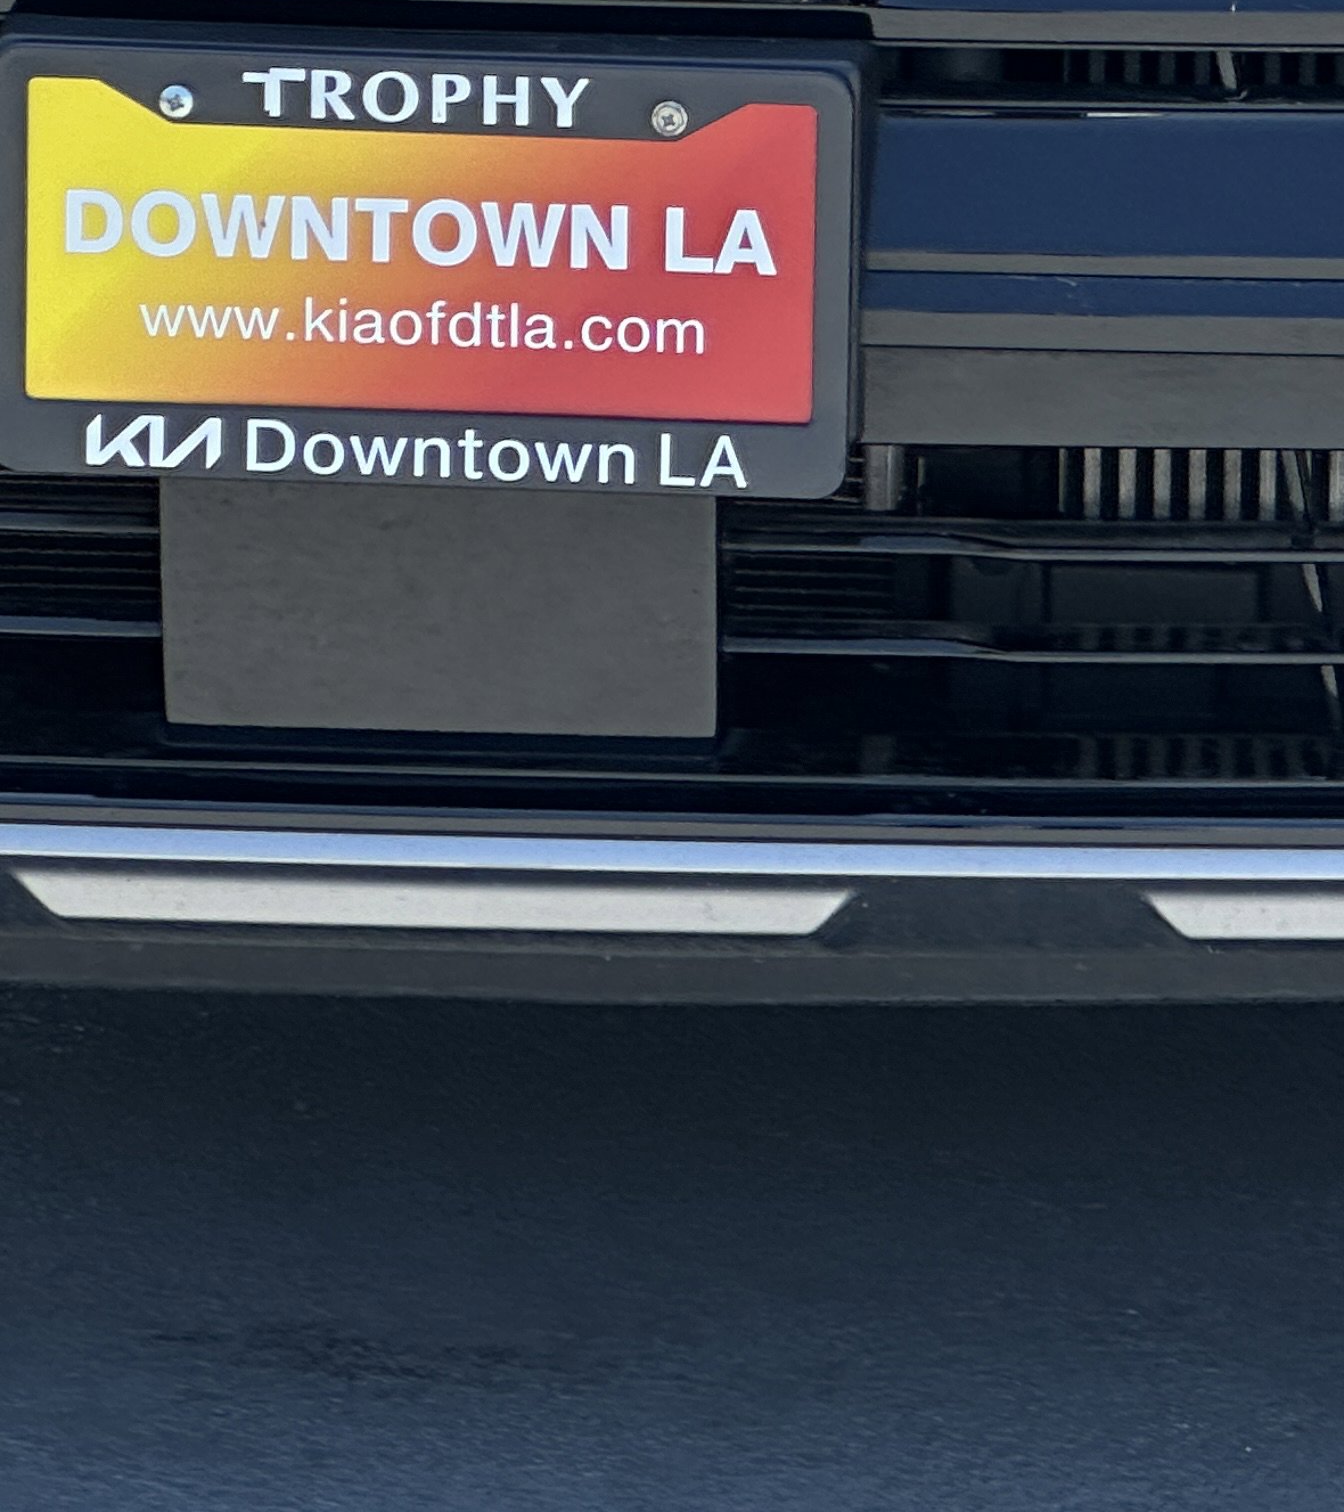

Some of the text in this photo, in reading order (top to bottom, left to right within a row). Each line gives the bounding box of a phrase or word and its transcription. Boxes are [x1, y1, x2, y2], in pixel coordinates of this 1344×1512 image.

[241, 66, 591, 129] TROPHY
[62, 186, 779, 277] DOWNTOWN LA
[138, 295, 706, 356] www.kiaofdtla.com
[84, 412, 750, 490] KIA Downtown LA
